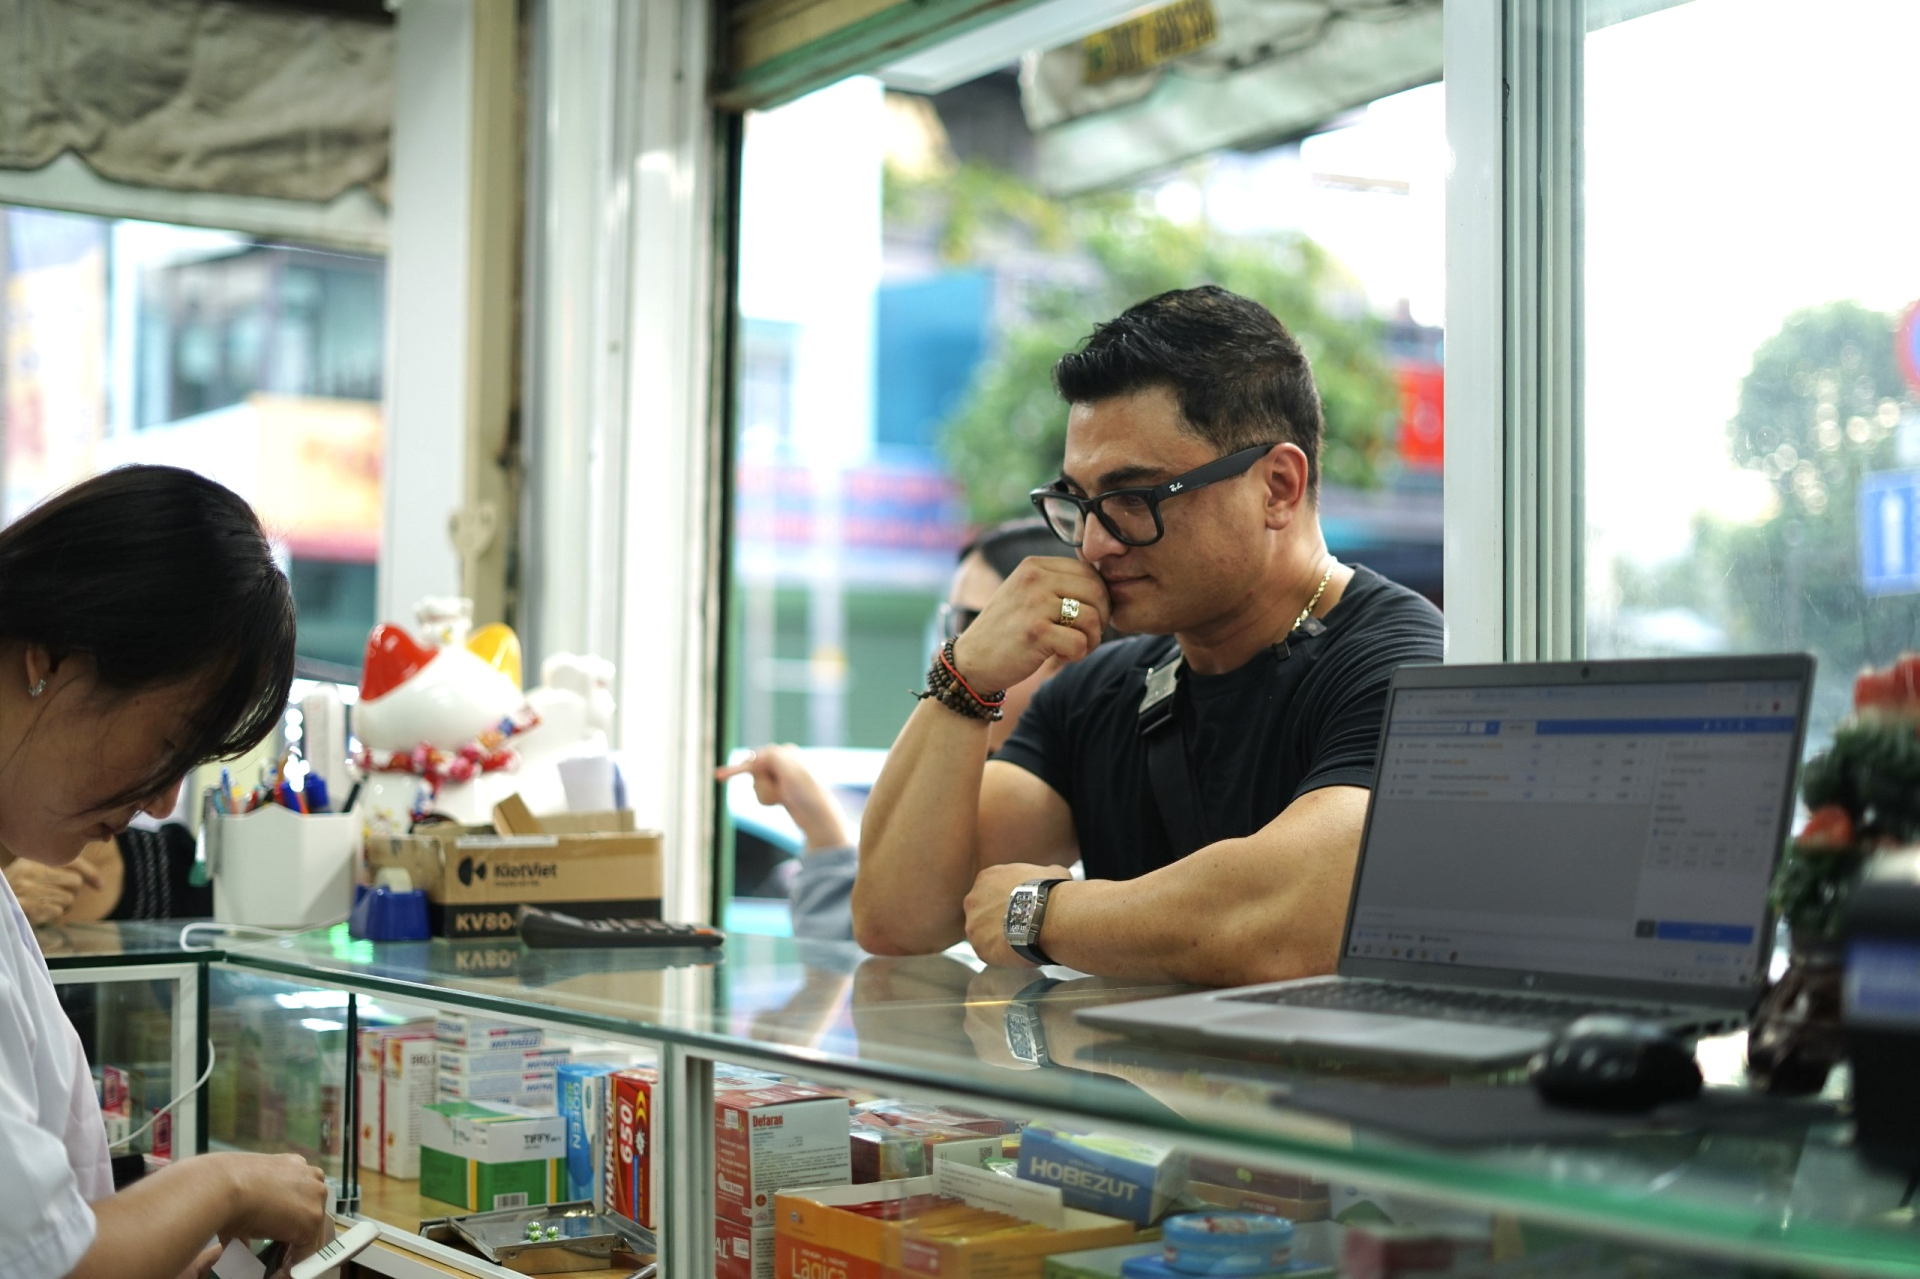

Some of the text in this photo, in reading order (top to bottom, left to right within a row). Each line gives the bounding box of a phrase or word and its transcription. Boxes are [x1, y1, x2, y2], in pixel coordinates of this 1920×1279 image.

[455, 911, 517, 931] KV80
[619, 1104, 634, 1164] 650
[752, 1114, 784, 1128] Defaran
[1029, 1156, 1140, 1202] HOBEZUT
